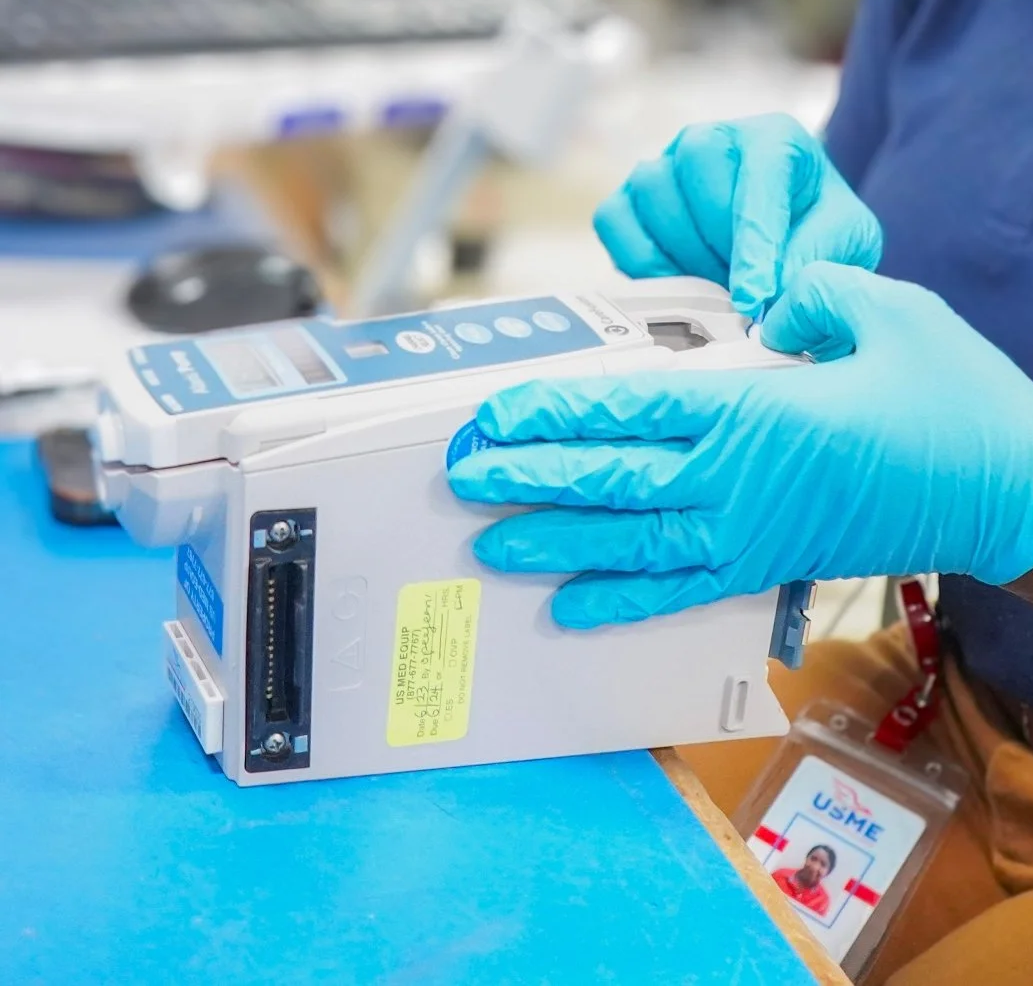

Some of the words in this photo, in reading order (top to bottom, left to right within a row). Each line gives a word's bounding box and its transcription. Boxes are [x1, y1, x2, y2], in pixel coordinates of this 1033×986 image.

[400, 627, 410, 660] EQUIP
[397, 663, 407, 687] MED
[396, 691, 405, 705] US
[417, 719, 425, 737] Date
[422, 668, 431, 679] By
[430, 719, 438, 736] Due
[813, 792, 885, 842] USME
